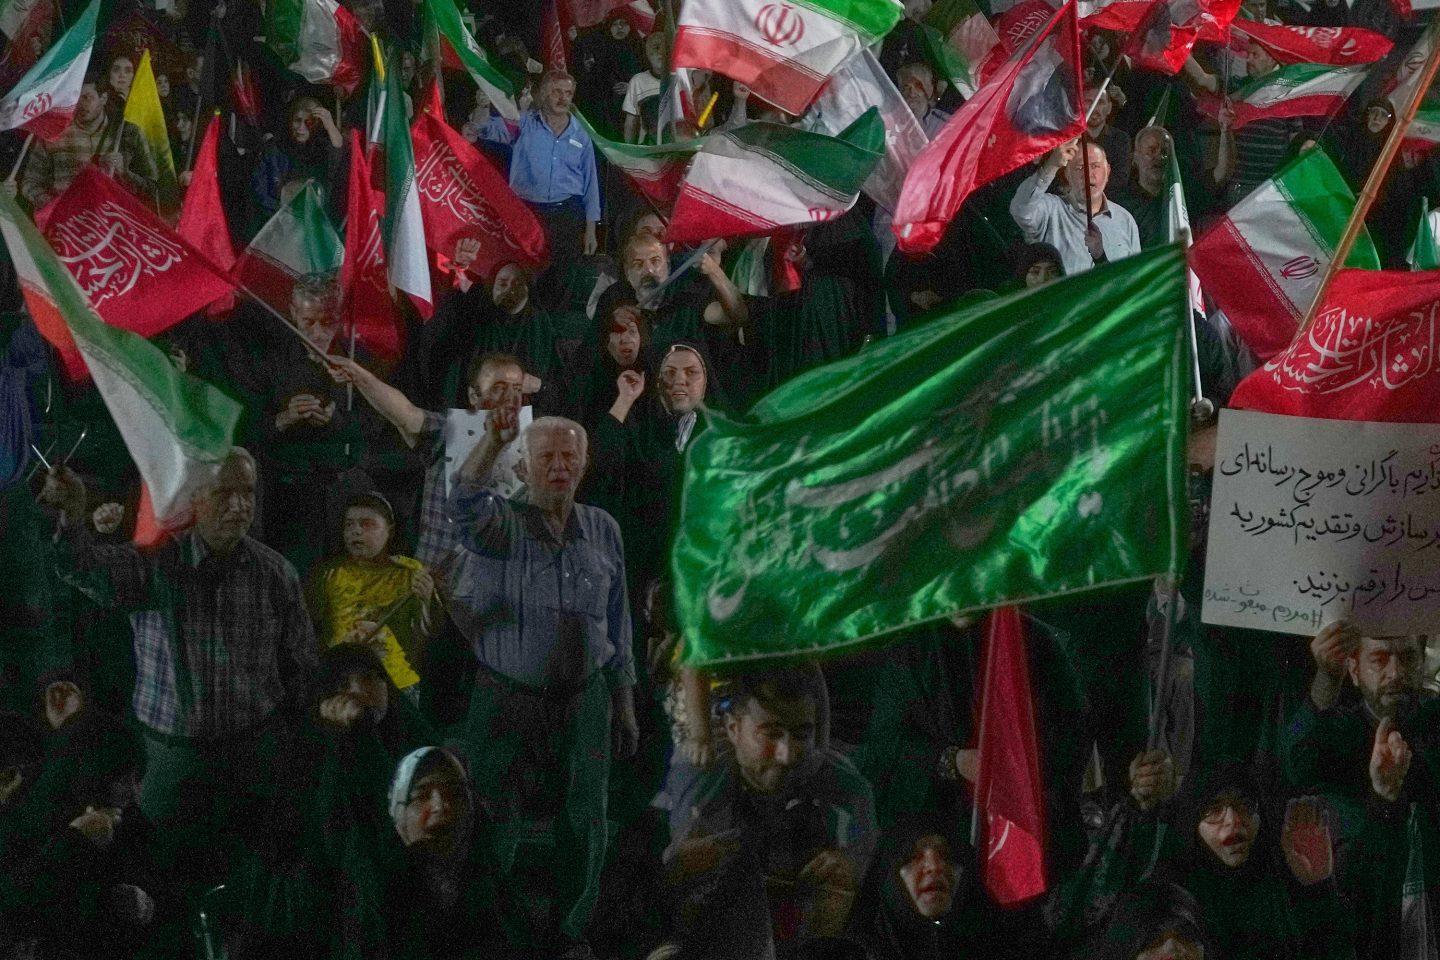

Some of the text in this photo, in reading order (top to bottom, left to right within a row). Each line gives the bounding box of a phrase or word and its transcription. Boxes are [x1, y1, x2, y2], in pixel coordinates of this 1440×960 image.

[1230, 501, 1254, 528] به
[1244, 503, 1311, 536] کشور
[1363, 513, 1430, 548] سازش
